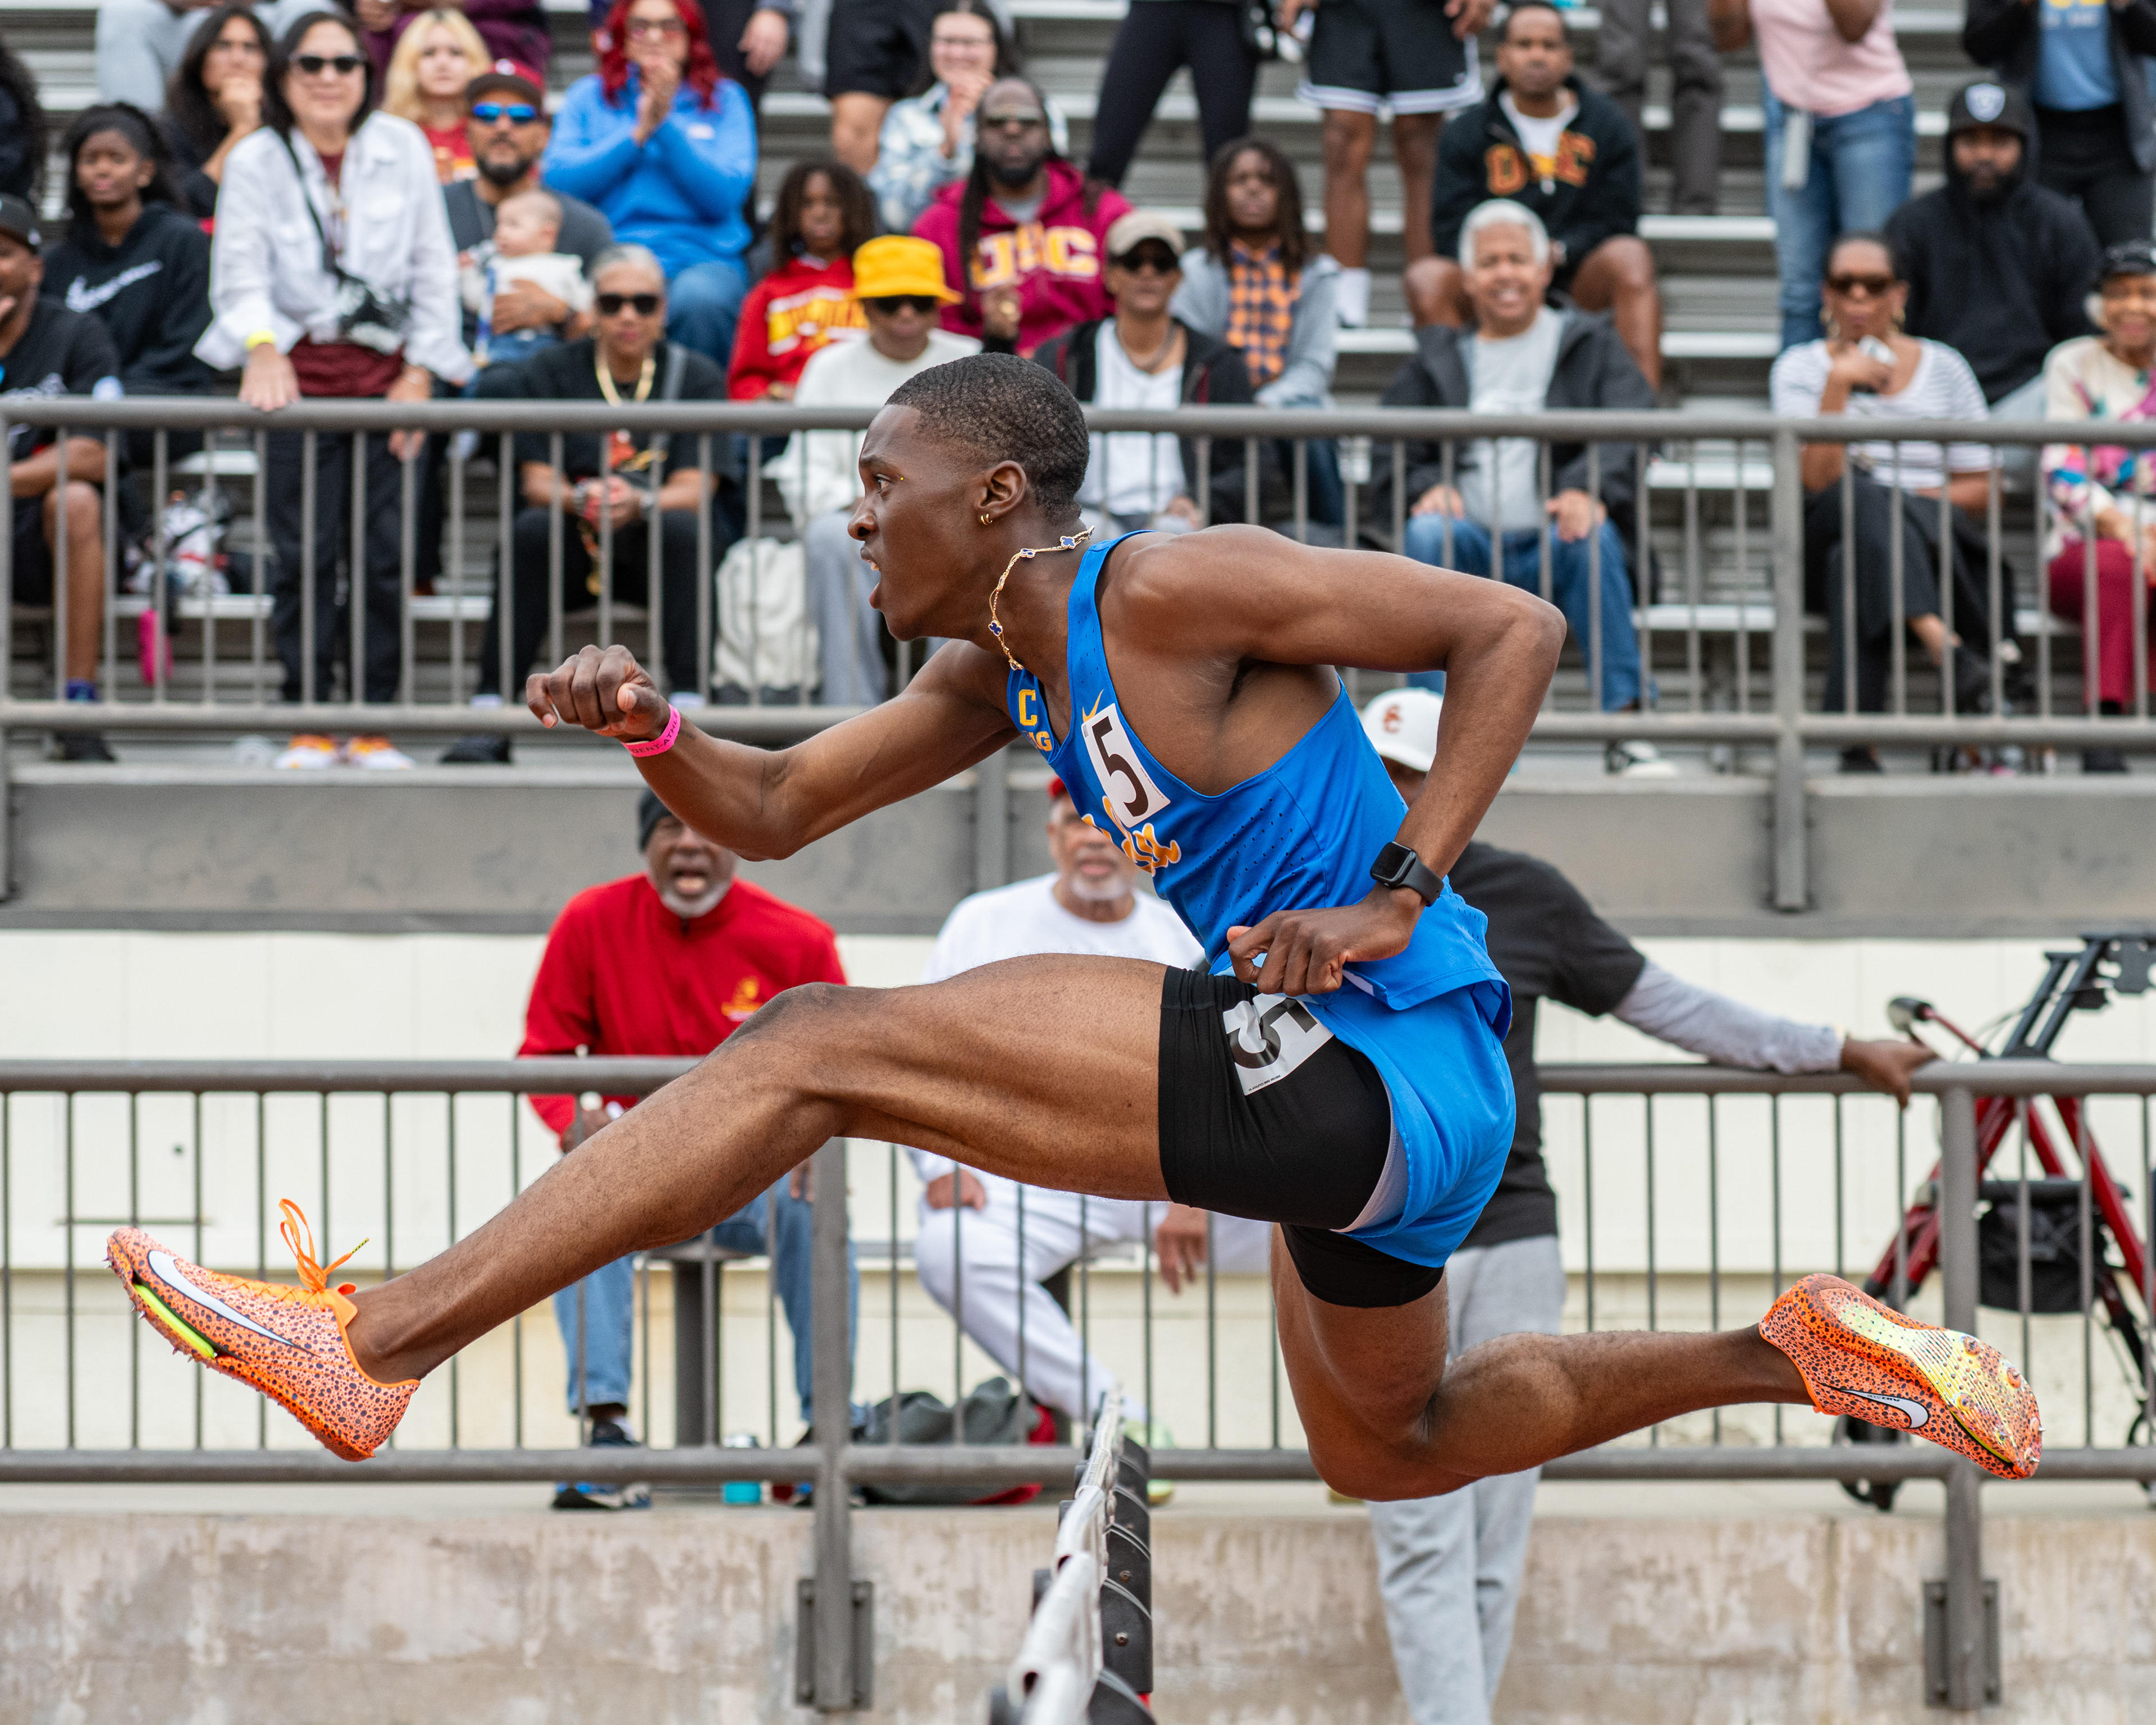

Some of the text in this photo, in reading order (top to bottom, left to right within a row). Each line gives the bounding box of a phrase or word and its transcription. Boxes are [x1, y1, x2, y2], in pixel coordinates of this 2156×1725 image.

[1018, 689, 1038, 726] C
[1092, 715, 1149, 817] 5
[1227, 997, 1318, 1069] 5
